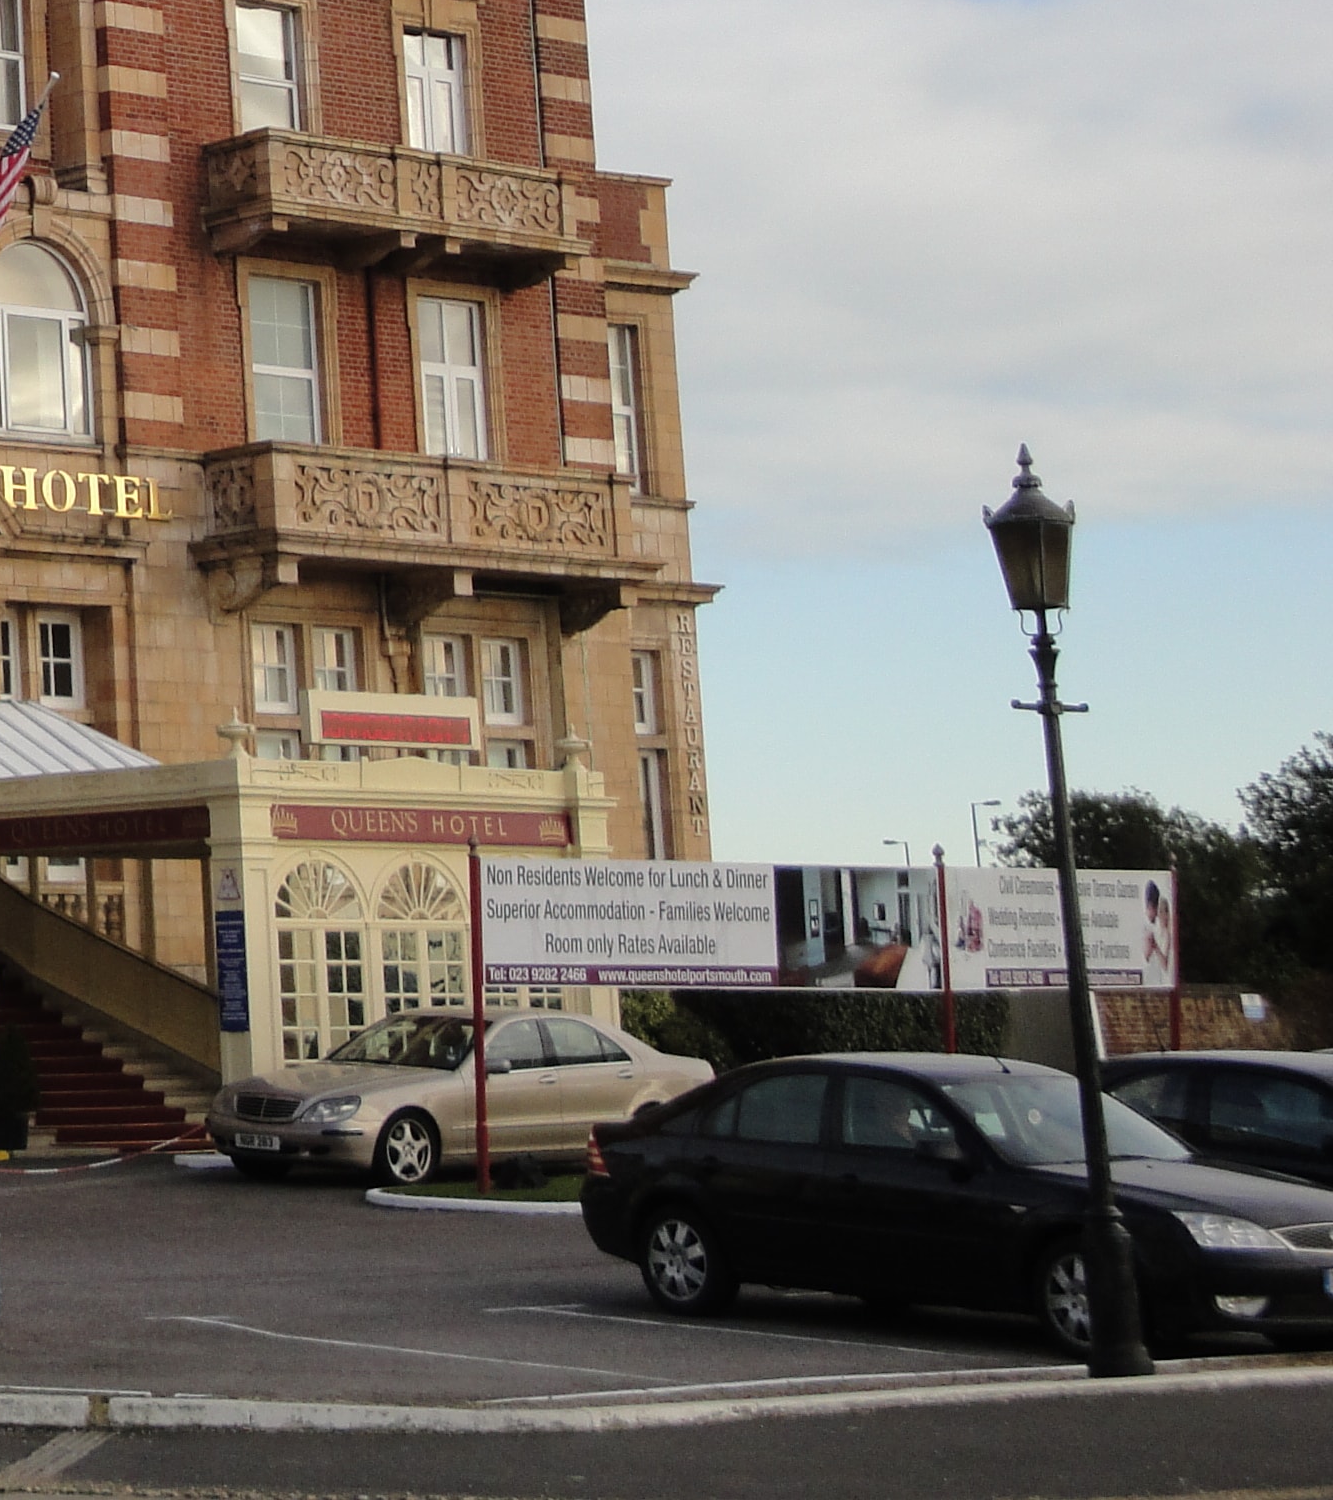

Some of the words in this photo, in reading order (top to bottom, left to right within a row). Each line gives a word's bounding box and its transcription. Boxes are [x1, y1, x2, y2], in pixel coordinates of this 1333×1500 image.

[0, 465, 173, 521] HOTEL
[677, 613, 705, 838] RESTAURANT
[98, 814, 167, 837] HOTEL
[431, 815, 508, 837] HOTEL
[487, 865, 513, 887] Non
[517, 866, 582, 887] Residents
[585, 866, 644, 888] Welcome
[648, 867, 666, 888] for
[670, 868, 709, 889] Lunch
[712, 868, 723, 889] &
[726, 869, 769, 890] Dinner
[486, 899, 541, 924] Superior
[544, 899, 646, 922] Accommodation
[659, 901, 711, 923] Families
[714, 902, 770, 923] Welcome
[545, 933, 583, 954] Room
[587, 934, 614, 959] only
[618, 934, 655, 955] Rates
[658, 934, 717, 956] Available
[489, 968, 508, 982] Tel:
[509, 968, 530, 982] 023
[531, 968, 559, 982] 9282
[561, 968, 587, 982] 2466
[598, 968, 773, 985] www.queenshotelportsmouth.com
